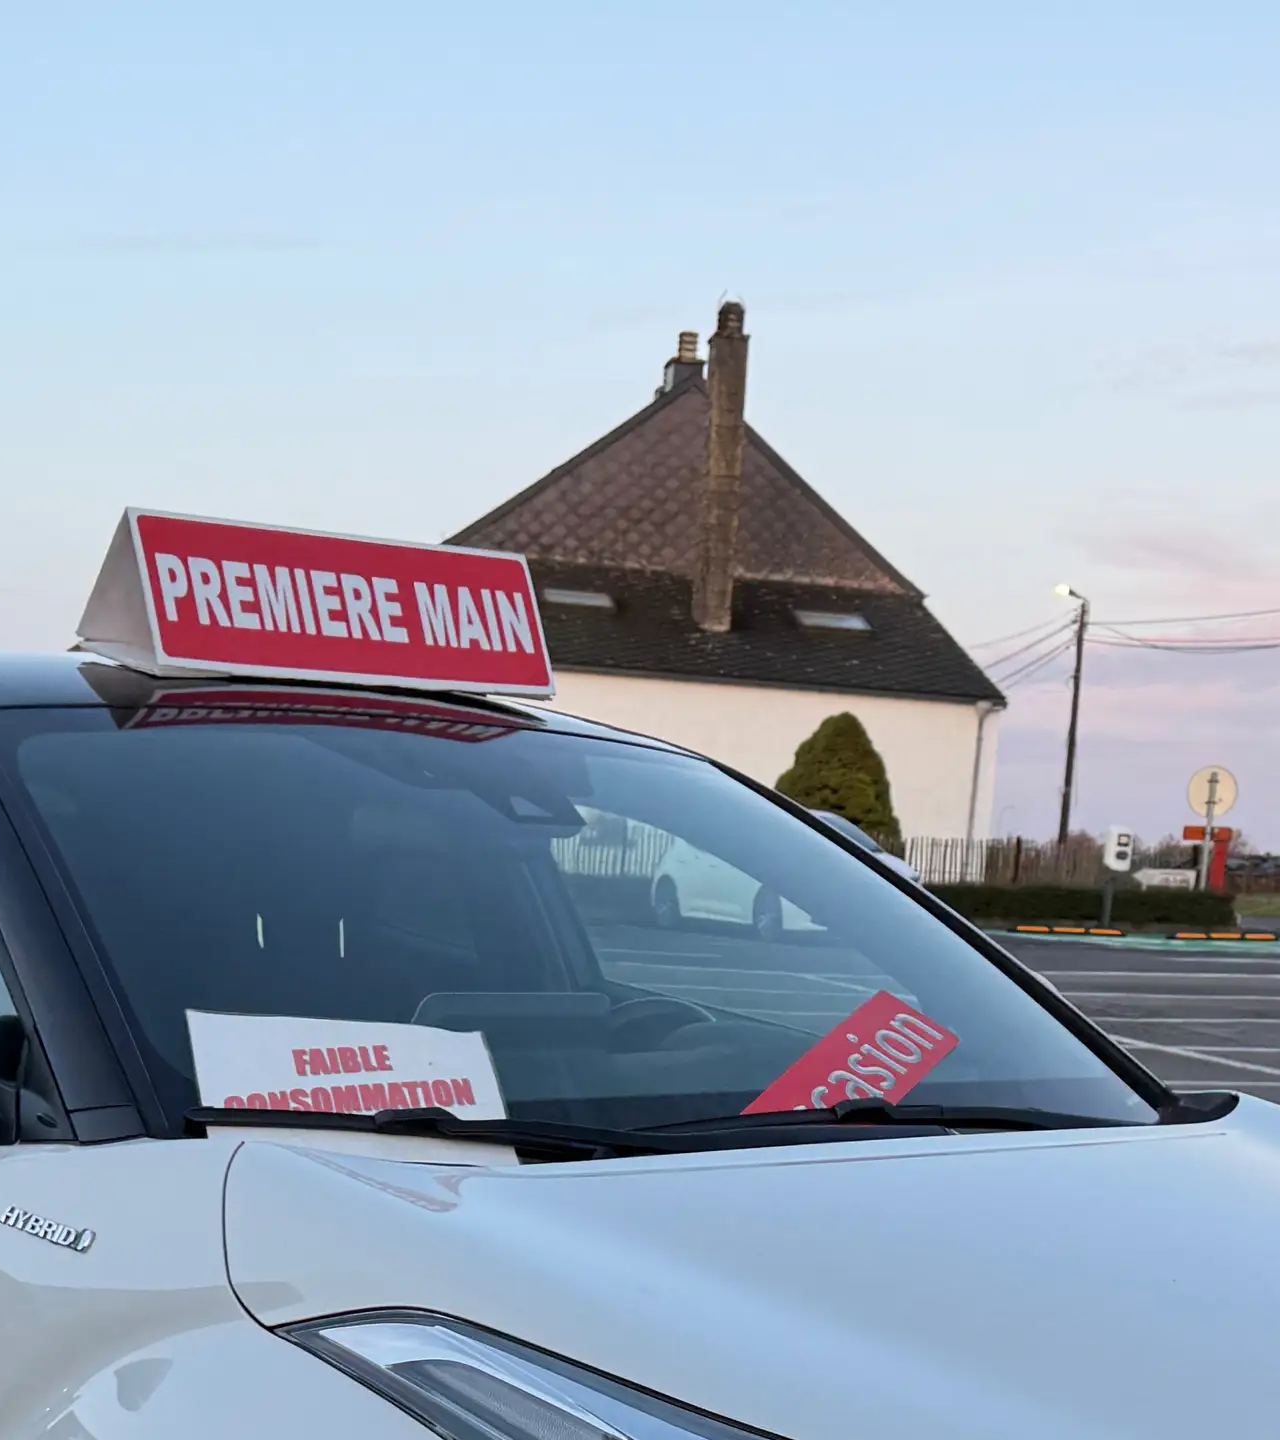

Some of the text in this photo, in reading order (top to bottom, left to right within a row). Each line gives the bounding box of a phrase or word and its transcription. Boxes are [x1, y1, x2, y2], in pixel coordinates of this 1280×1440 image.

[154, 552, 535, 654] PREMIERE MAIN
[292, 1045, 393, 1076] FAIBLE
[0, 1205, 78, 1247] HYBRID
